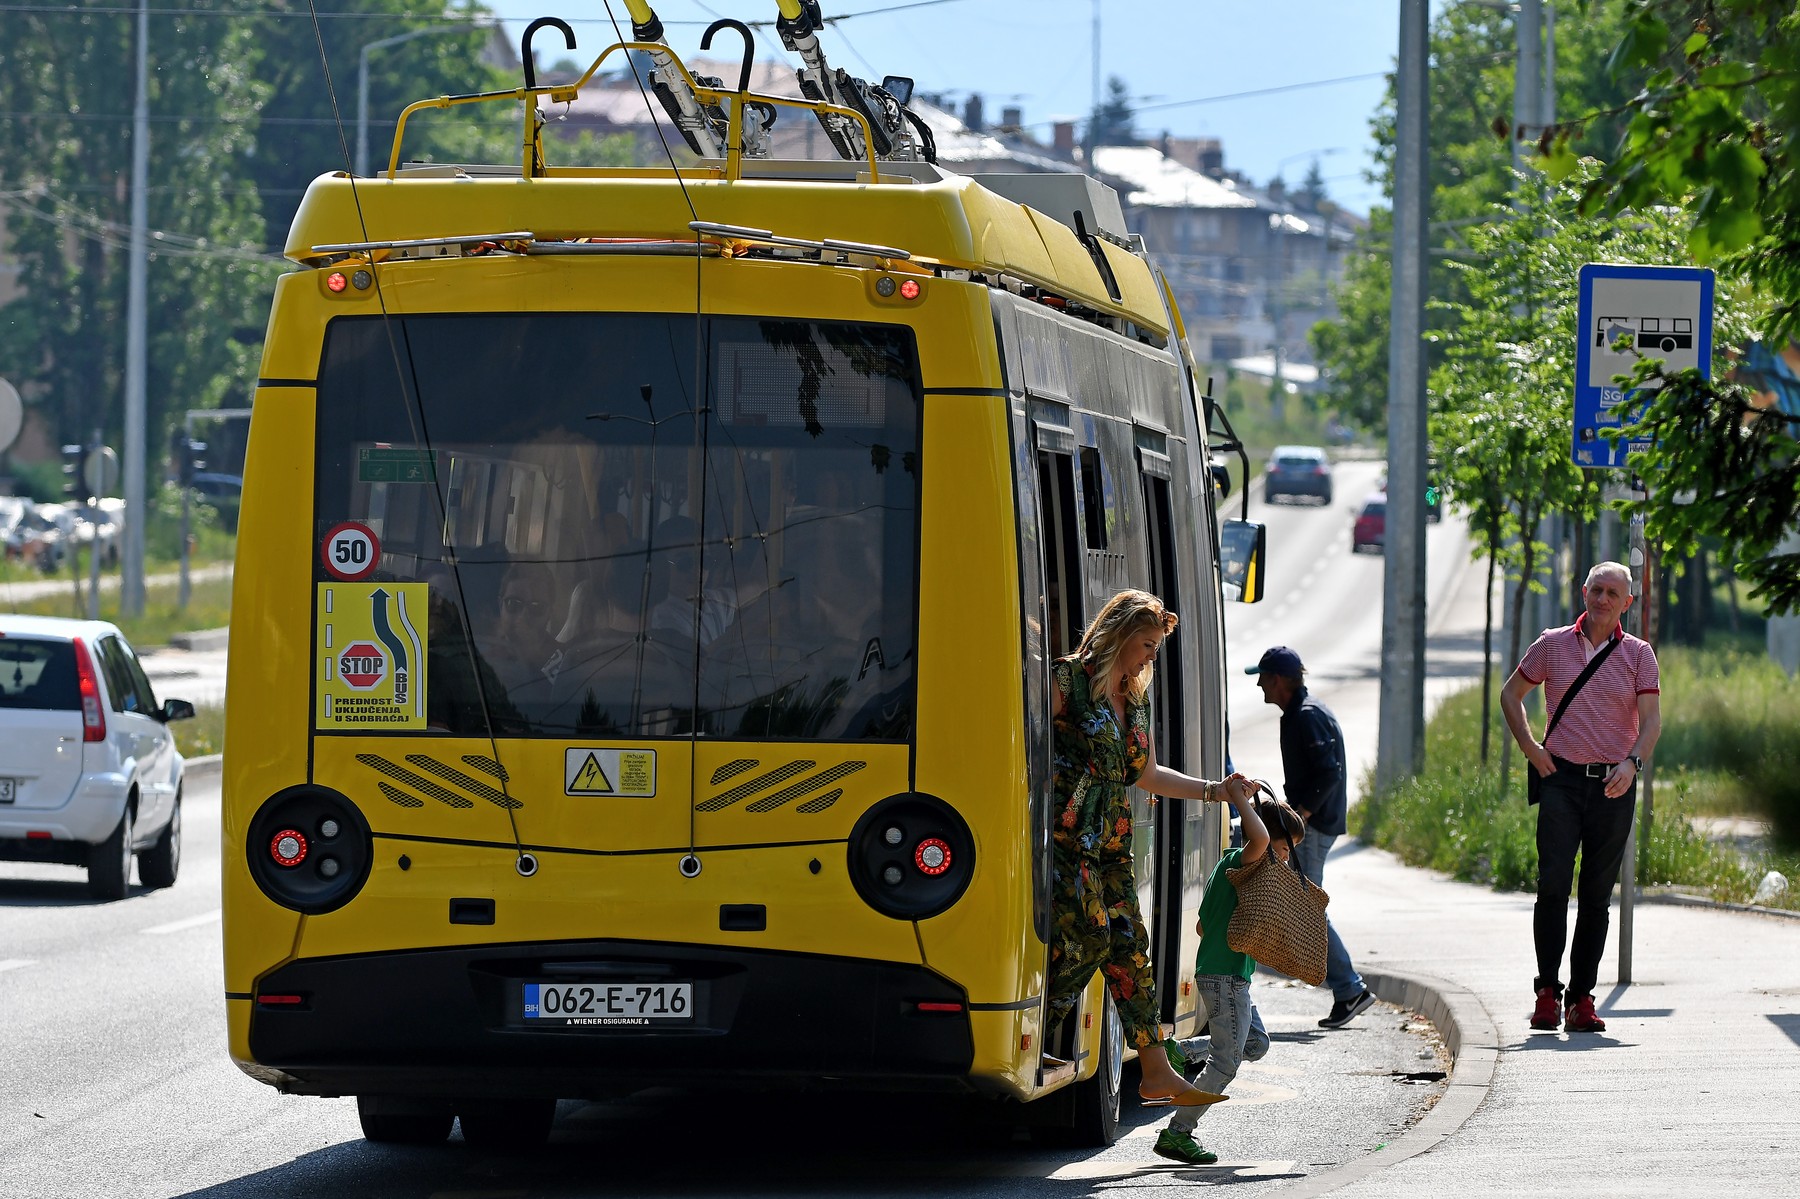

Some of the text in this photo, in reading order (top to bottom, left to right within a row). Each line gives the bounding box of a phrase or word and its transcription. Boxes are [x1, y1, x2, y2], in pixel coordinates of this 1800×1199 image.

[1604, 391, 1622, 401] SG
[335, 539, 367, 564] 50
[340, 657, 383, 674] STOP
[395, 673, 408, 704] BUS
[335, 706, 401, 714] UKLJUČENJA
[345, 714, 409, 722] SAOBRAĆAJ
[544, 987, 686, 1014] 062-E-716
